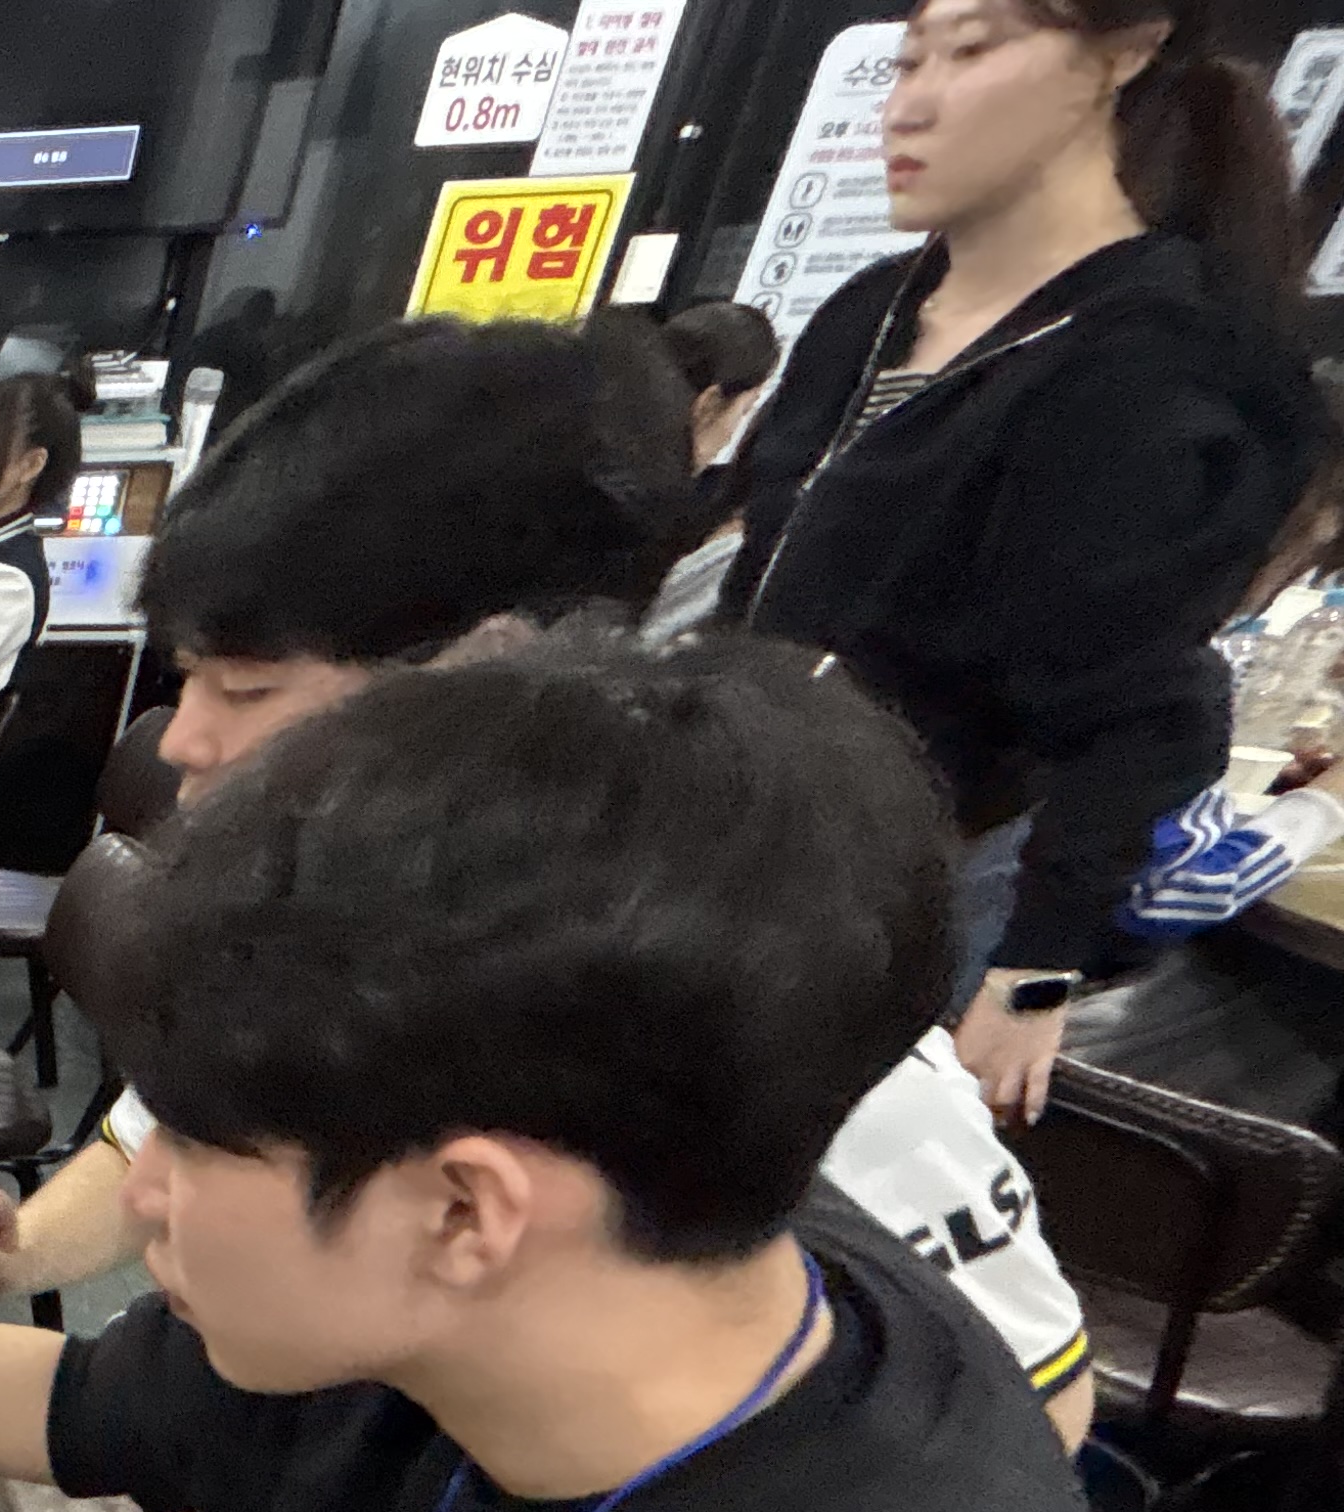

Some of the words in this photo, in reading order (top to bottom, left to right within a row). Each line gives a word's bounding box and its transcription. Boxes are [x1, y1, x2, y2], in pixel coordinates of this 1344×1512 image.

[439, 56, 507, 88] 현위치
[511, 51, 558, 83] 수심
[445, 96, 521, 132] 0.8m
[453, 203, 597, 284] 위험
